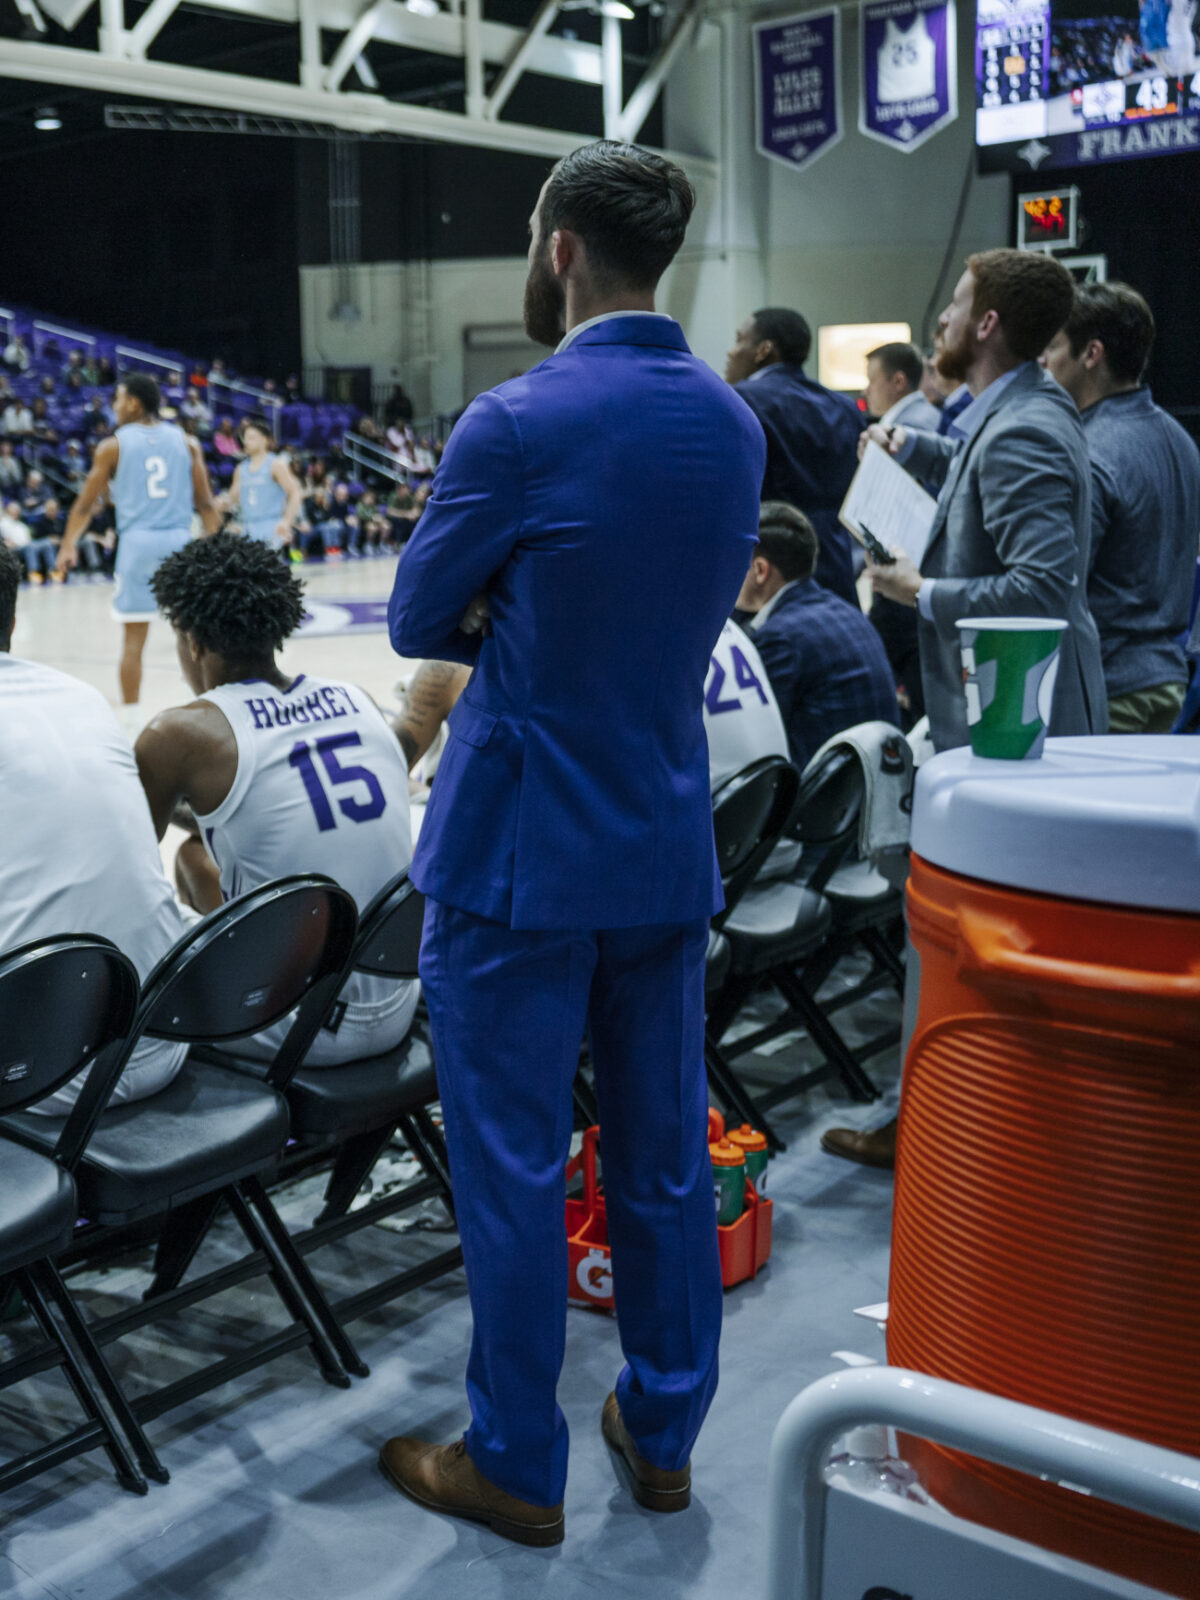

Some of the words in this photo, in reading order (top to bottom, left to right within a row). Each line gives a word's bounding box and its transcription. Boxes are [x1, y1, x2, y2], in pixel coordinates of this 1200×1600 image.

[1078, 116, 1199, 161] FRANK
[145, 456, 168, 498] 2
[705, 645, 768, 716] 24
[289, 730, 387, 833] 15
